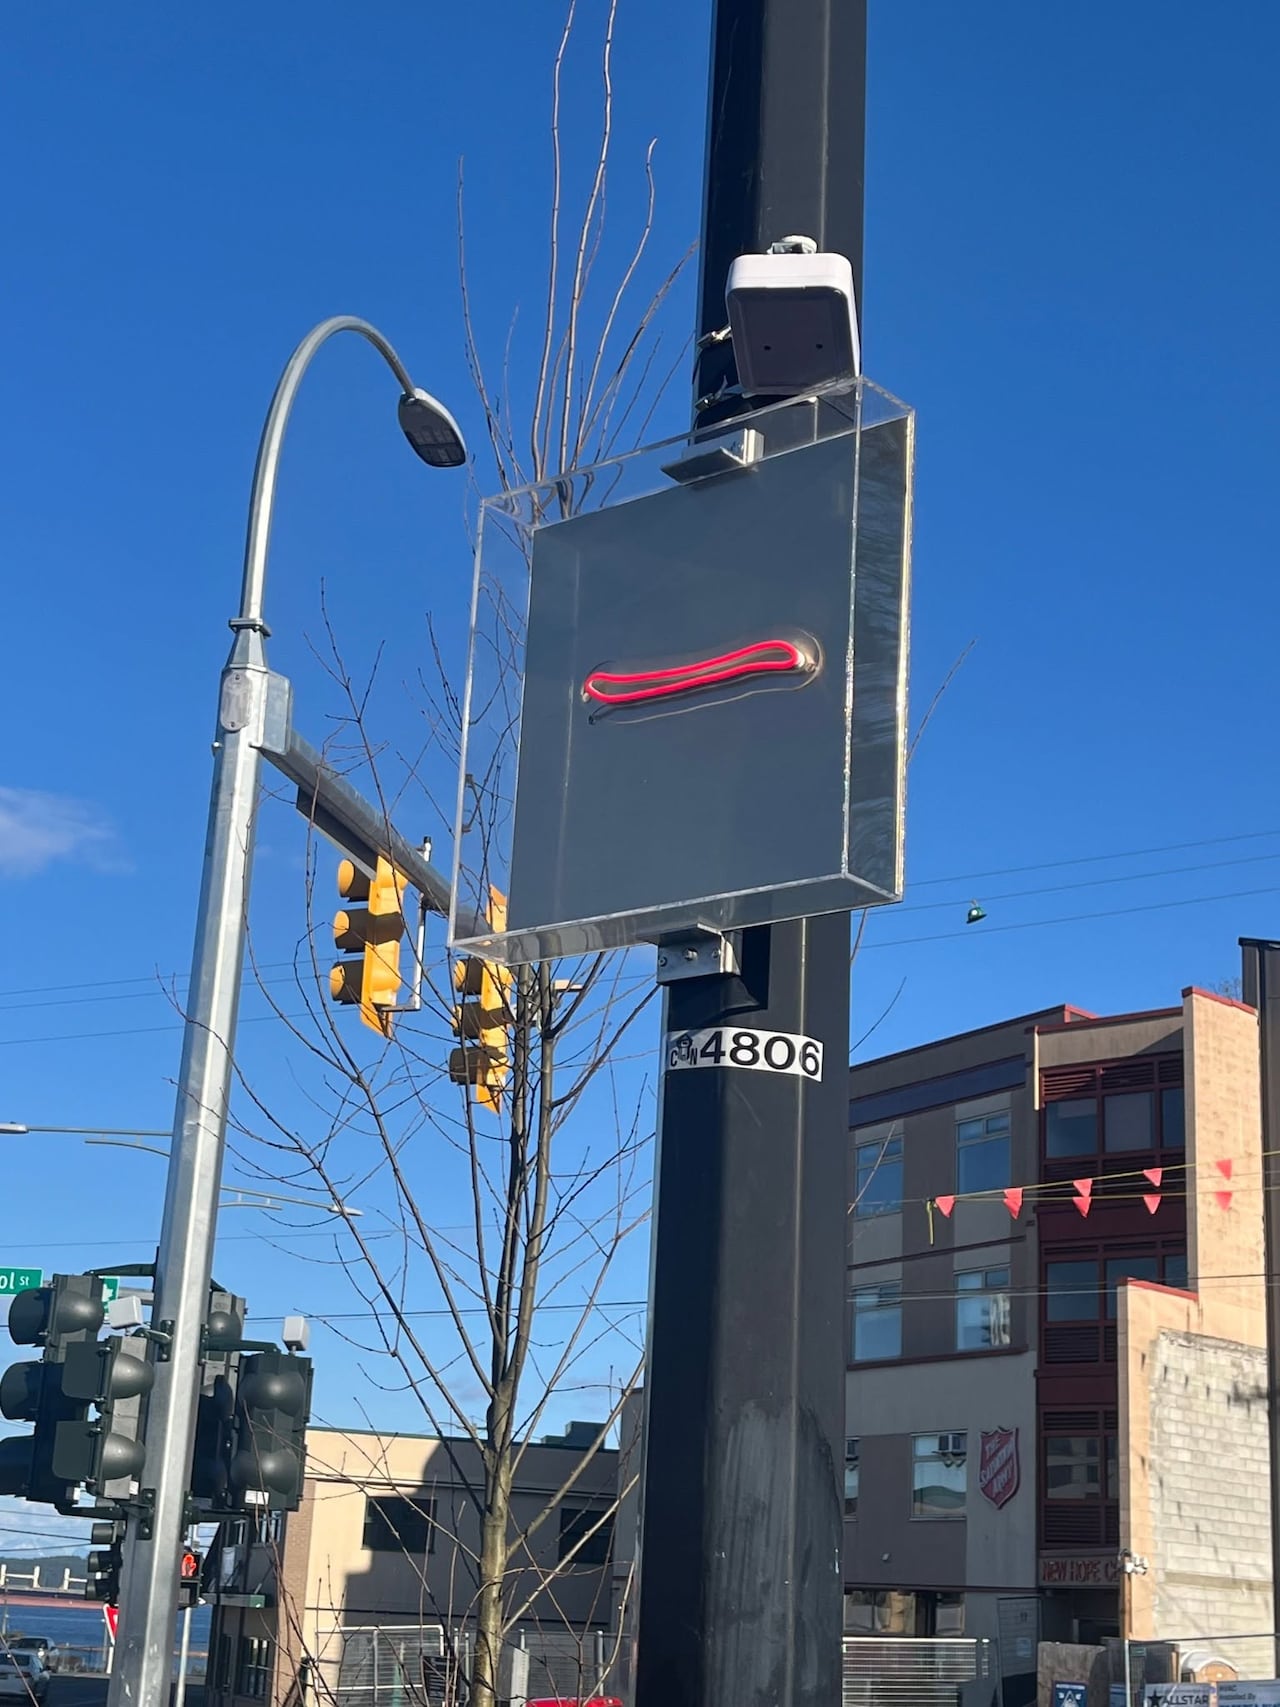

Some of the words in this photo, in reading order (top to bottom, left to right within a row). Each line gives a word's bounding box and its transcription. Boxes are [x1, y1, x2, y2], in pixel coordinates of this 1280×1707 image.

[699, 1030, 820, 1077] 4806
[19, 1275, 30, 1287] St
[1070, 1559, 1101, 1582] HOPE
[1162, 1694, 1210, 1706] ALLSTAR
